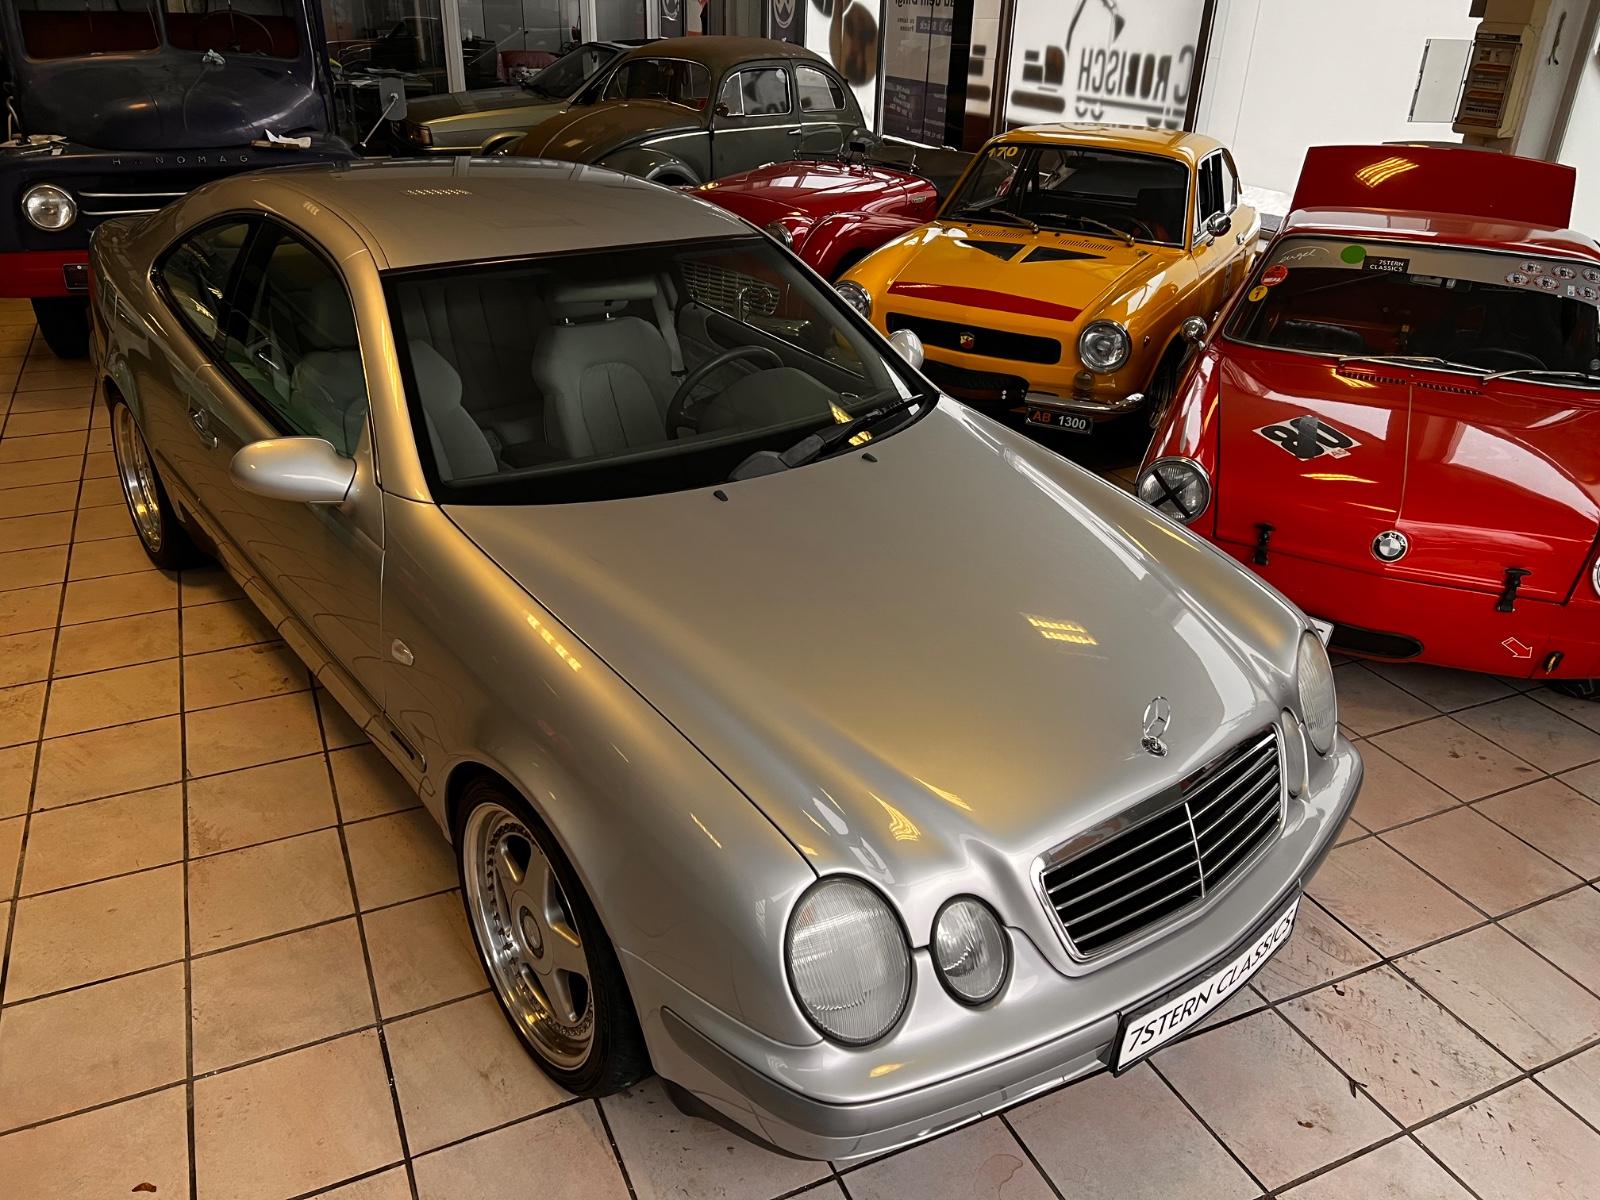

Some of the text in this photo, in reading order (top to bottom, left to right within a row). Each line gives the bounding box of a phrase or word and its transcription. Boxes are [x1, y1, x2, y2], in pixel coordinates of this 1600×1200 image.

[112, 155, 249, 166] HNOMAG
[1369, 264, 1403, 272] CLASSICS
[1379, 259, 1404, 267] 7STERN
[1032, 410, 1087, 430] AB 1300
[1129, 908, 1295, 1053] 7STERN CLASSICS
